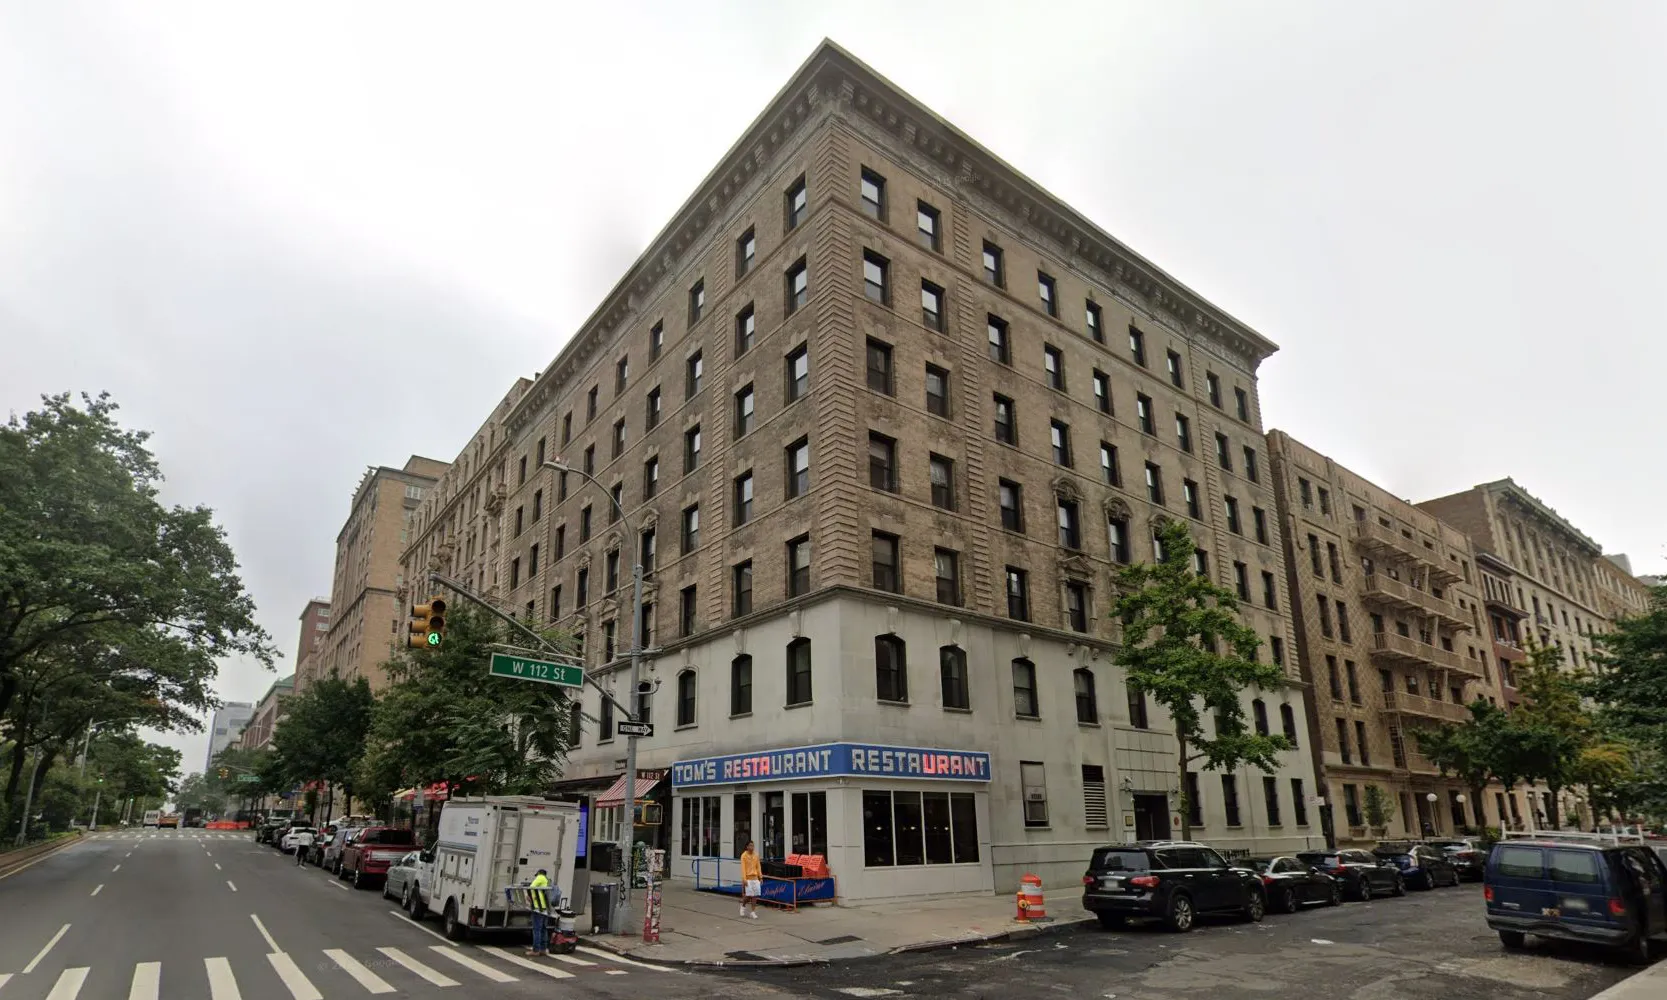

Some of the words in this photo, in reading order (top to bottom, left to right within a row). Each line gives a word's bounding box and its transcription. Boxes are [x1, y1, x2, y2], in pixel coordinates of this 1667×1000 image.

[512, 661, 524, 675] W
[529, 664, 548, 678] 112
[553, 667, 565, 681] St
[674, 760, 716, 782] TOM'S
[724, 750, 831, 778] RESTAURANT
[852, 749, 987, 776] RESTAURANT
